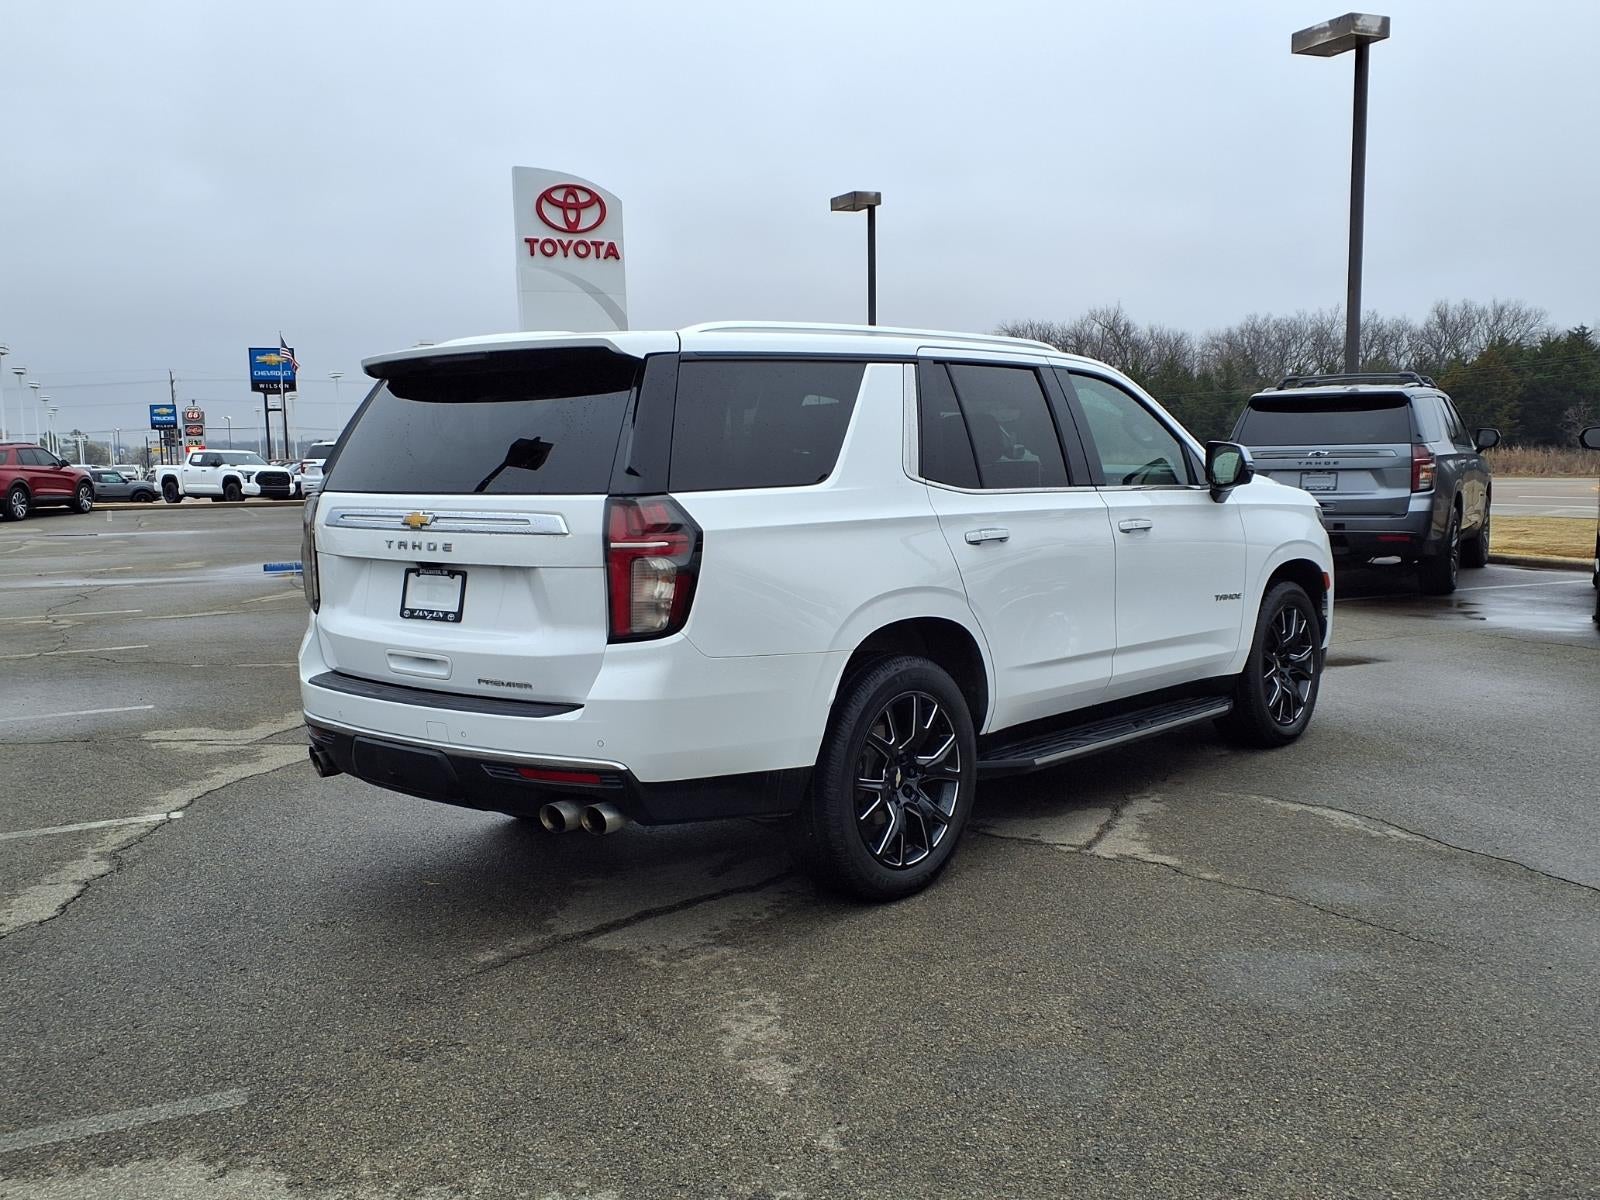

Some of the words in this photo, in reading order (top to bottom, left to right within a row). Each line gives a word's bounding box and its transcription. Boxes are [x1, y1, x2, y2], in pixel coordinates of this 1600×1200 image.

[524, 237, 620, 260] TOYOTA
[187, 411, 199, 419] 66
[385, 540, 453, 552] TAHOE
[1214, 592, 1242, 602] TAHOE
[413, 609, 444, 620] JANZEN
[477, 678, 533, 690] PREMIER
